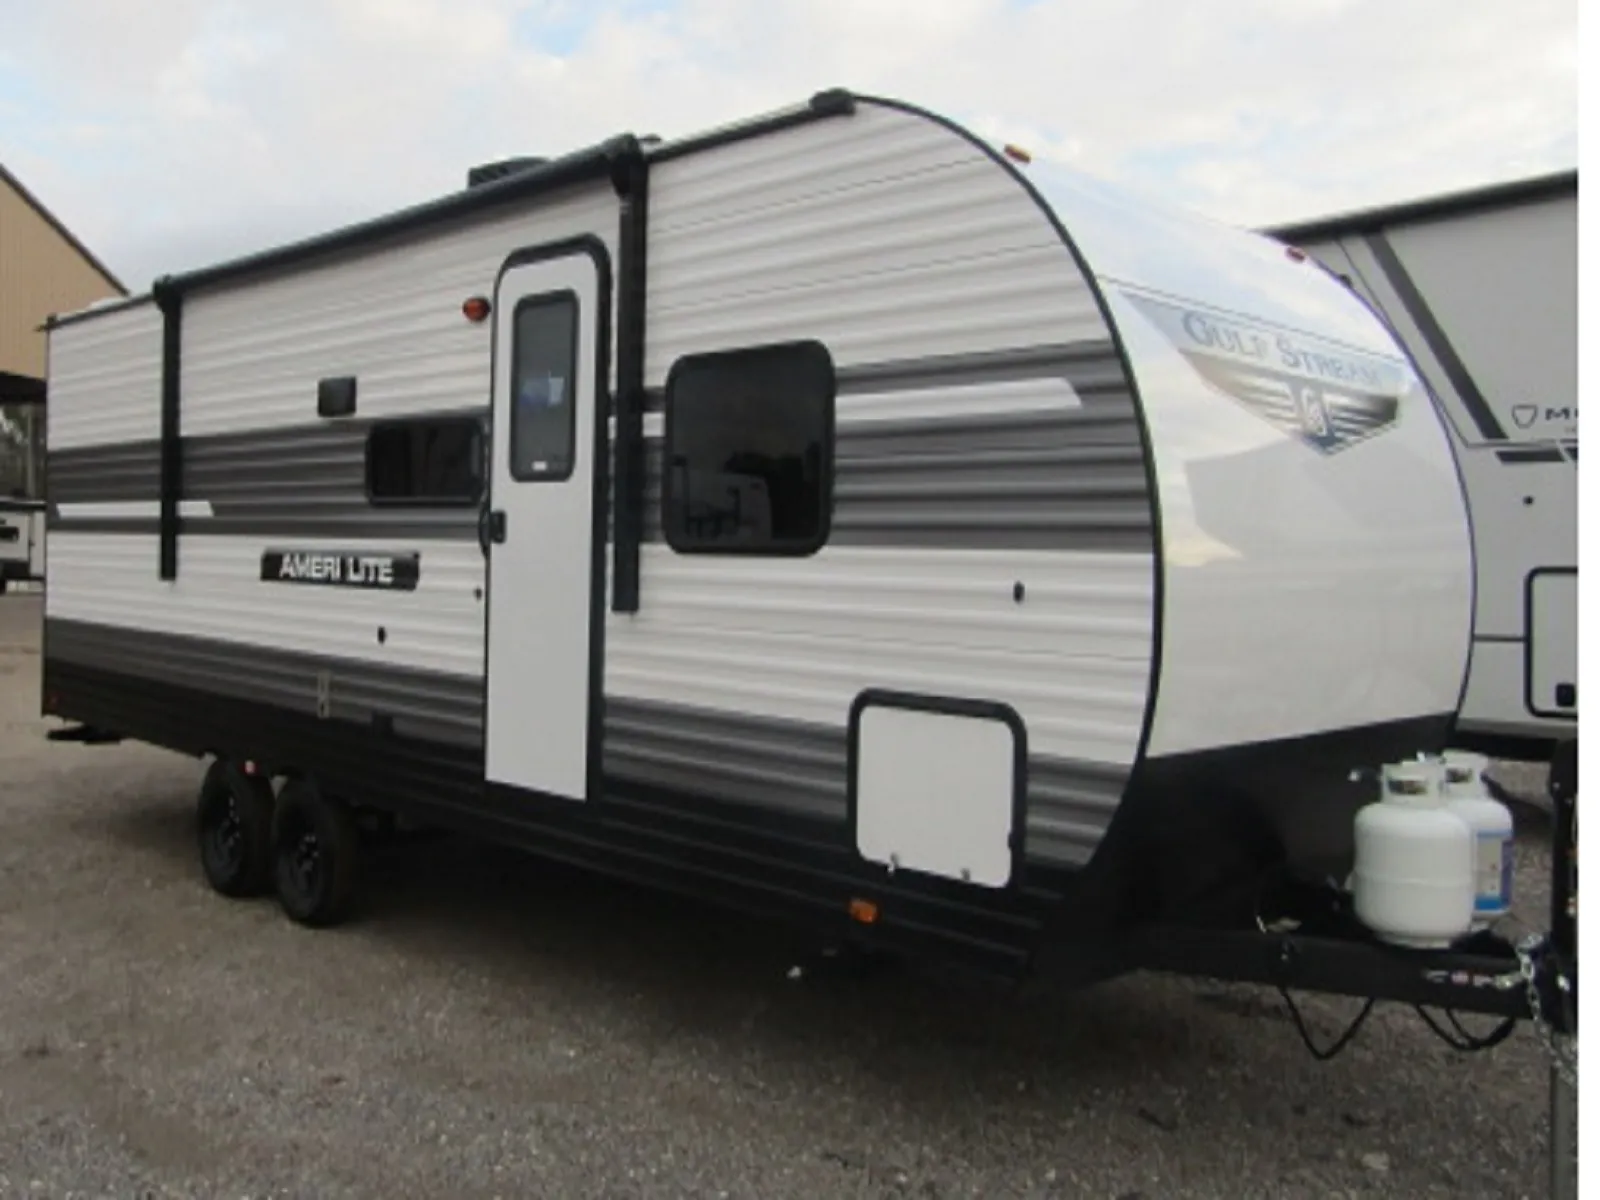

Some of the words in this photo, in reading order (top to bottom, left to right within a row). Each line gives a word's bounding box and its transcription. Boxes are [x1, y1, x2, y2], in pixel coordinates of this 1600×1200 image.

[1182, 310, 1268, 358] GULF
[1276, 334, 1383, 386] STREAM
[1545, 407, 1578, 421] M
[279, 553, 341, 580] AMERI
[346, 556, 393, 583] LITE
